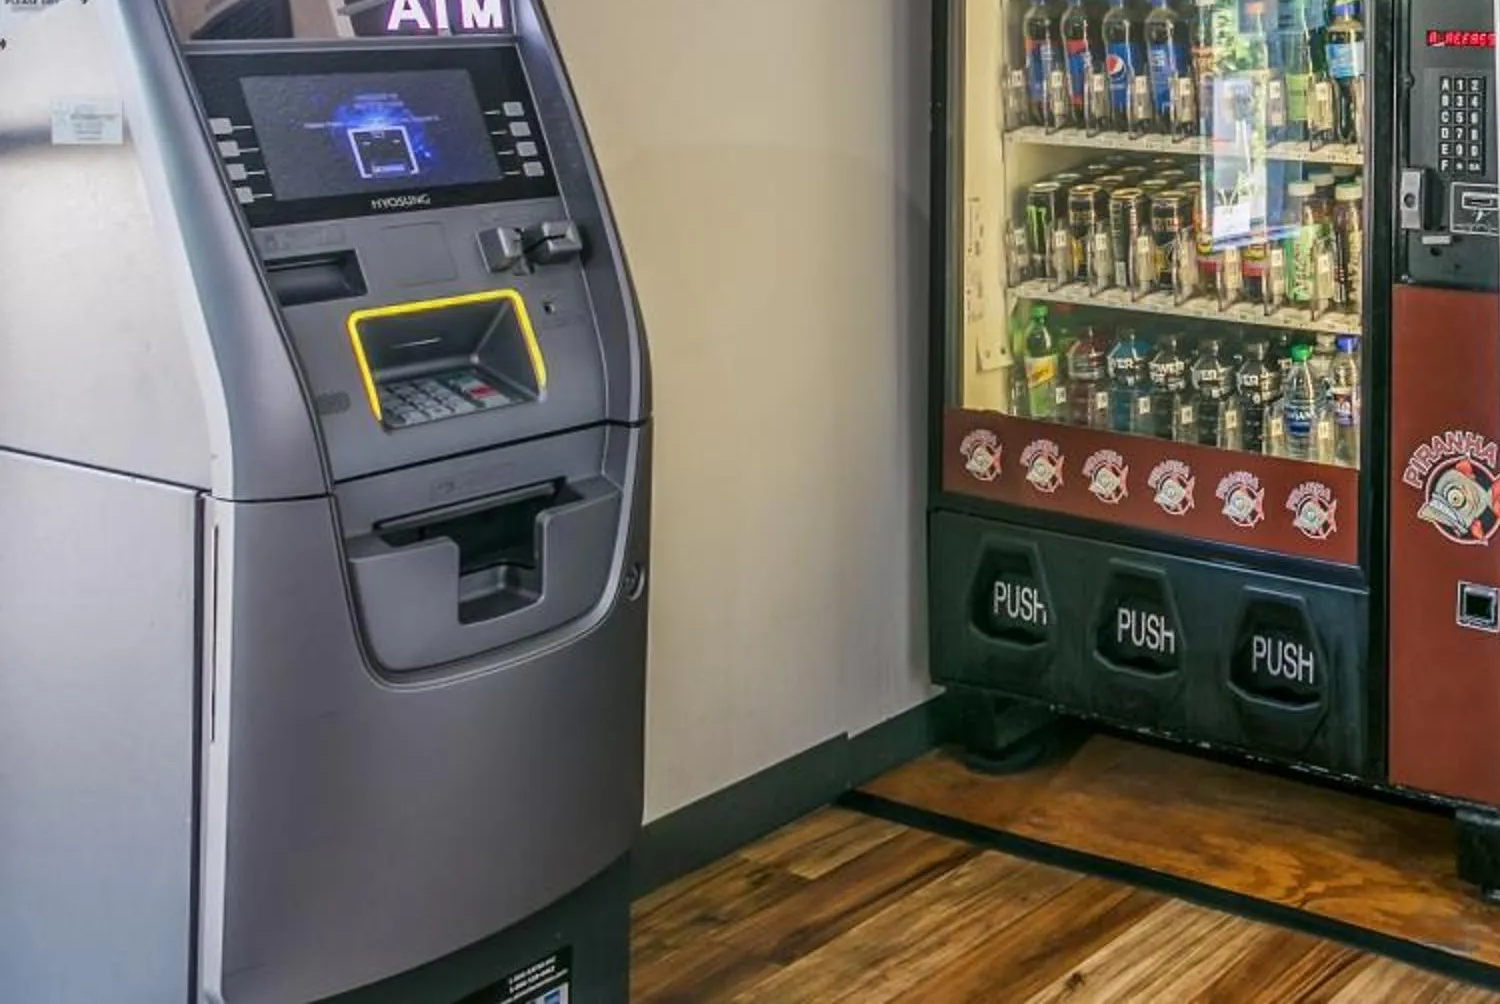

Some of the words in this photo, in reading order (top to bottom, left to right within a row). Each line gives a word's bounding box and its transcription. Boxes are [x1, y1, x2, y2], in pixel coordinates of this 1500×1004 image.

[1441, 78, 1449, 91] A
[1441, 111, 1449, 123] C
[1441, 143, 1449, 155] E
[1441, 159, 1449, 171] F
[371, 194, 431, 210] HYOSUNG
[1402, 431, 1499, 490] PIRANHA
[992, 581, 1048, 626] PUSH
[1116, 607, 1176, 655] PUSH
[1251, 635, 1315, 685] PUSH
